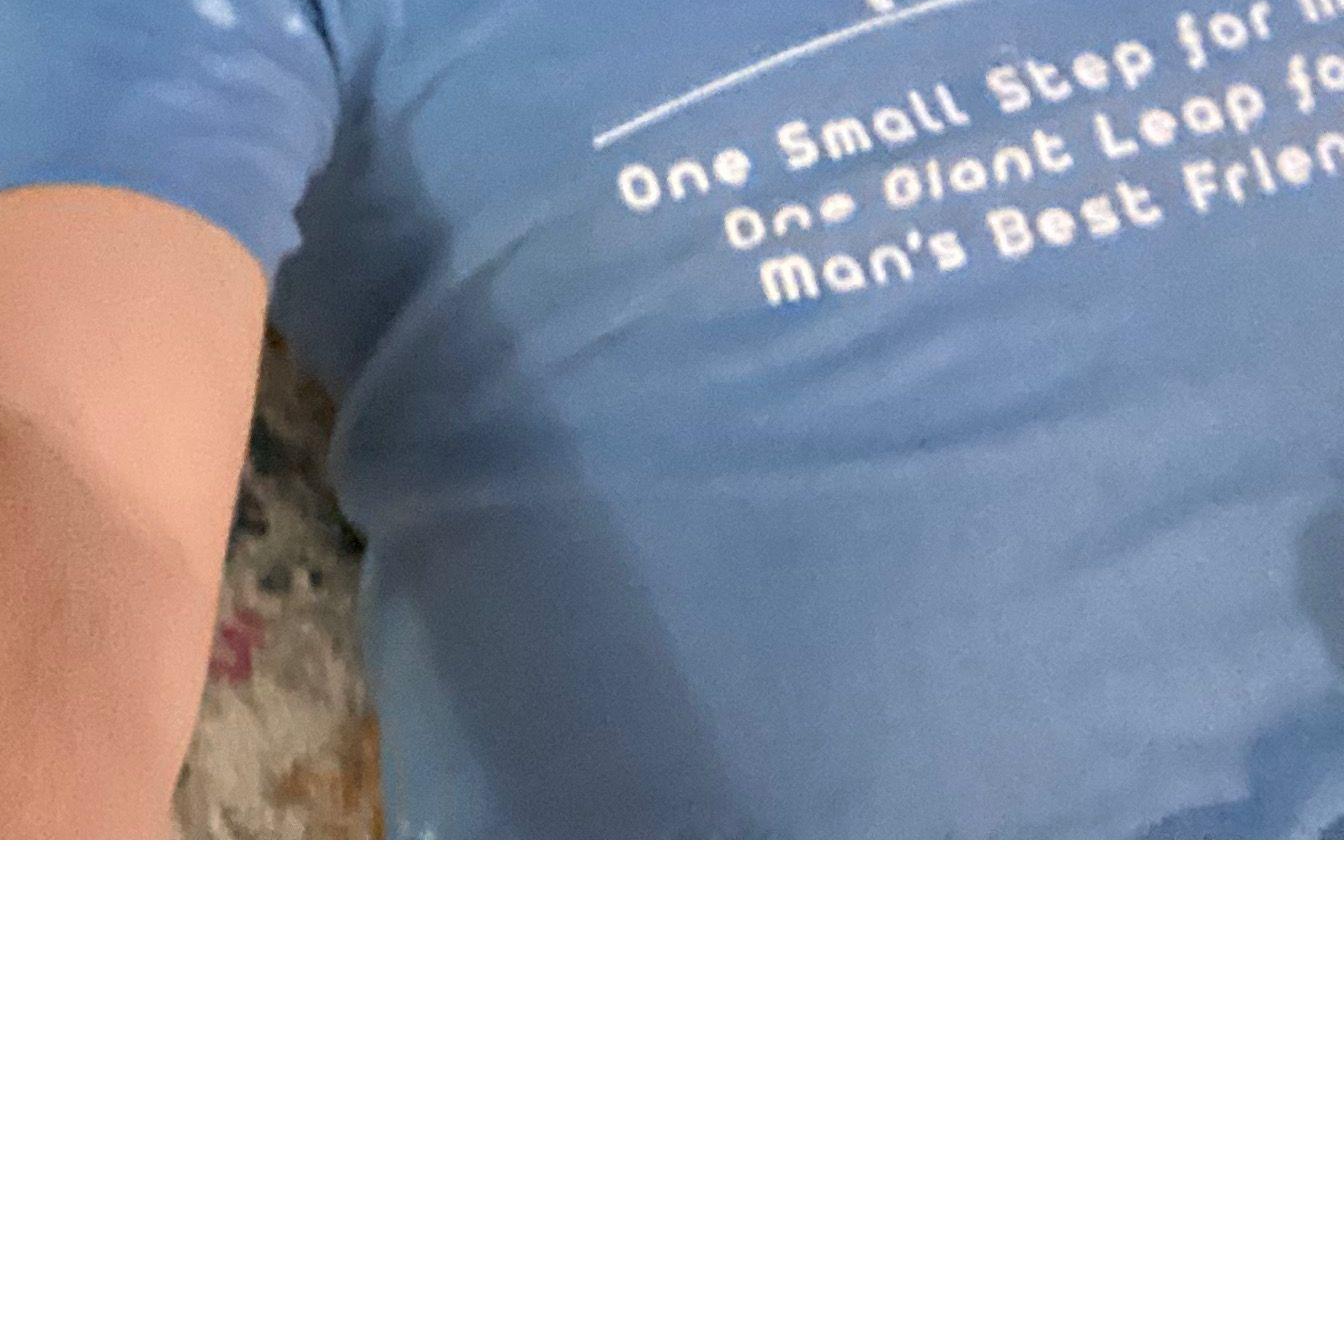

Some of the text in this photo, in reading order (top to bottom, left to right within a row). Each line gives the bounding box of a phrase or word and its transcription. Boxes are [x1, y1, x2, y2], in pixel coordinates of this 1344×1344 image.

[617, 148, 752, 213] One
[775, 83, 970, 171] Small
[984, 39, 1155, 114] Step
[1175, 0, 1271, 72] for
[723, 52, 1344, 251] One Giant Leap fo
[758, 130, 1344, 306] Man's Best Frien
